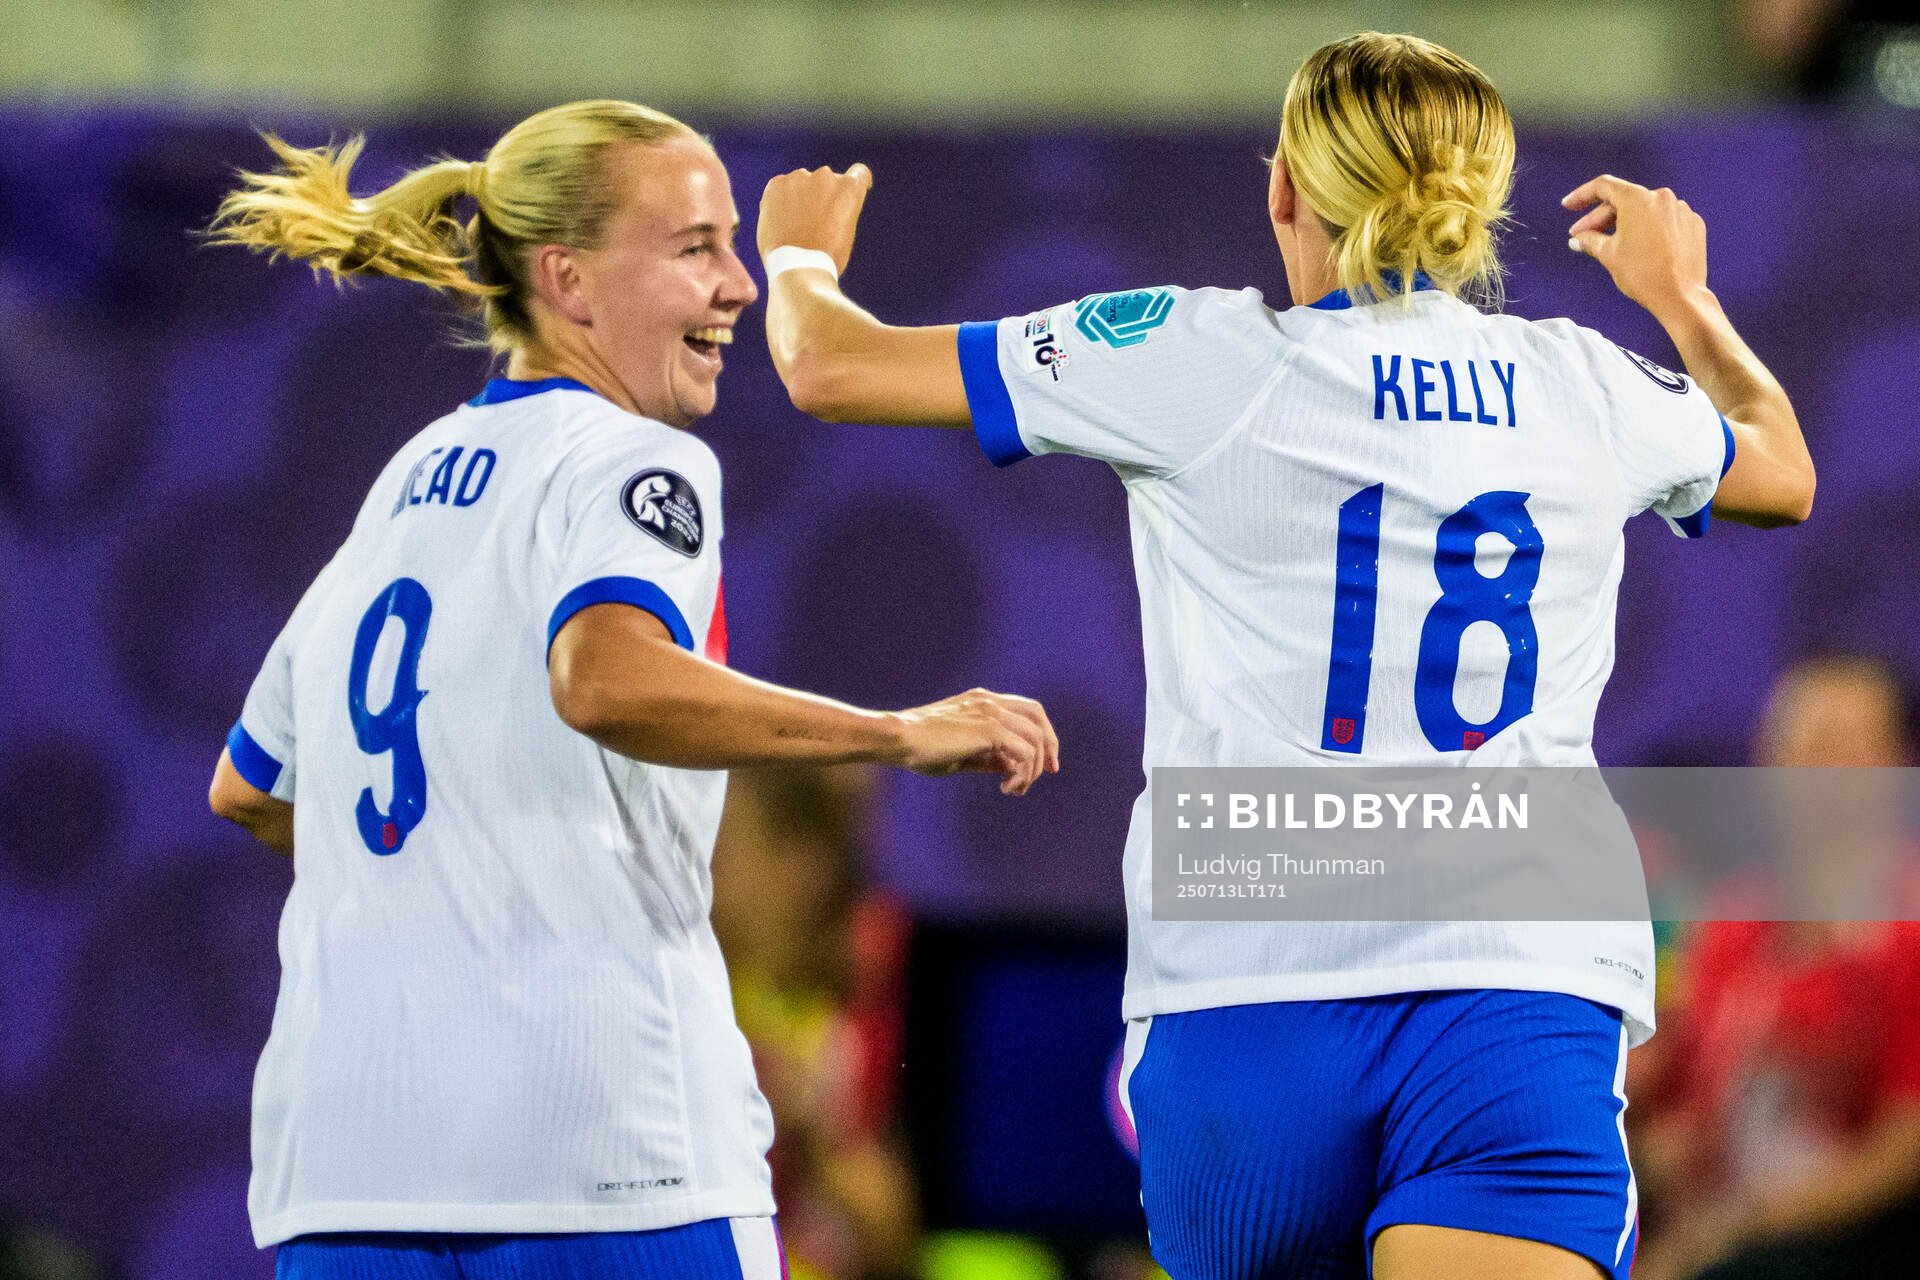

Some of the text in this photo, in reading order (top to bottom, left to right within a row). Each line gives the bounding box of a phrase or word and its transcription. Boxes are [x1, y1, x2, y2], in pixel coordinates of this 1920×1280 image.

[1033, 333, 1057, 366] 10
[1372, 355, 1516, 427] KELLY
[390, 446, 497, 519] EAD
[1321, 482, 1544, 754] 18
[348, 577, 432, 856] 9
